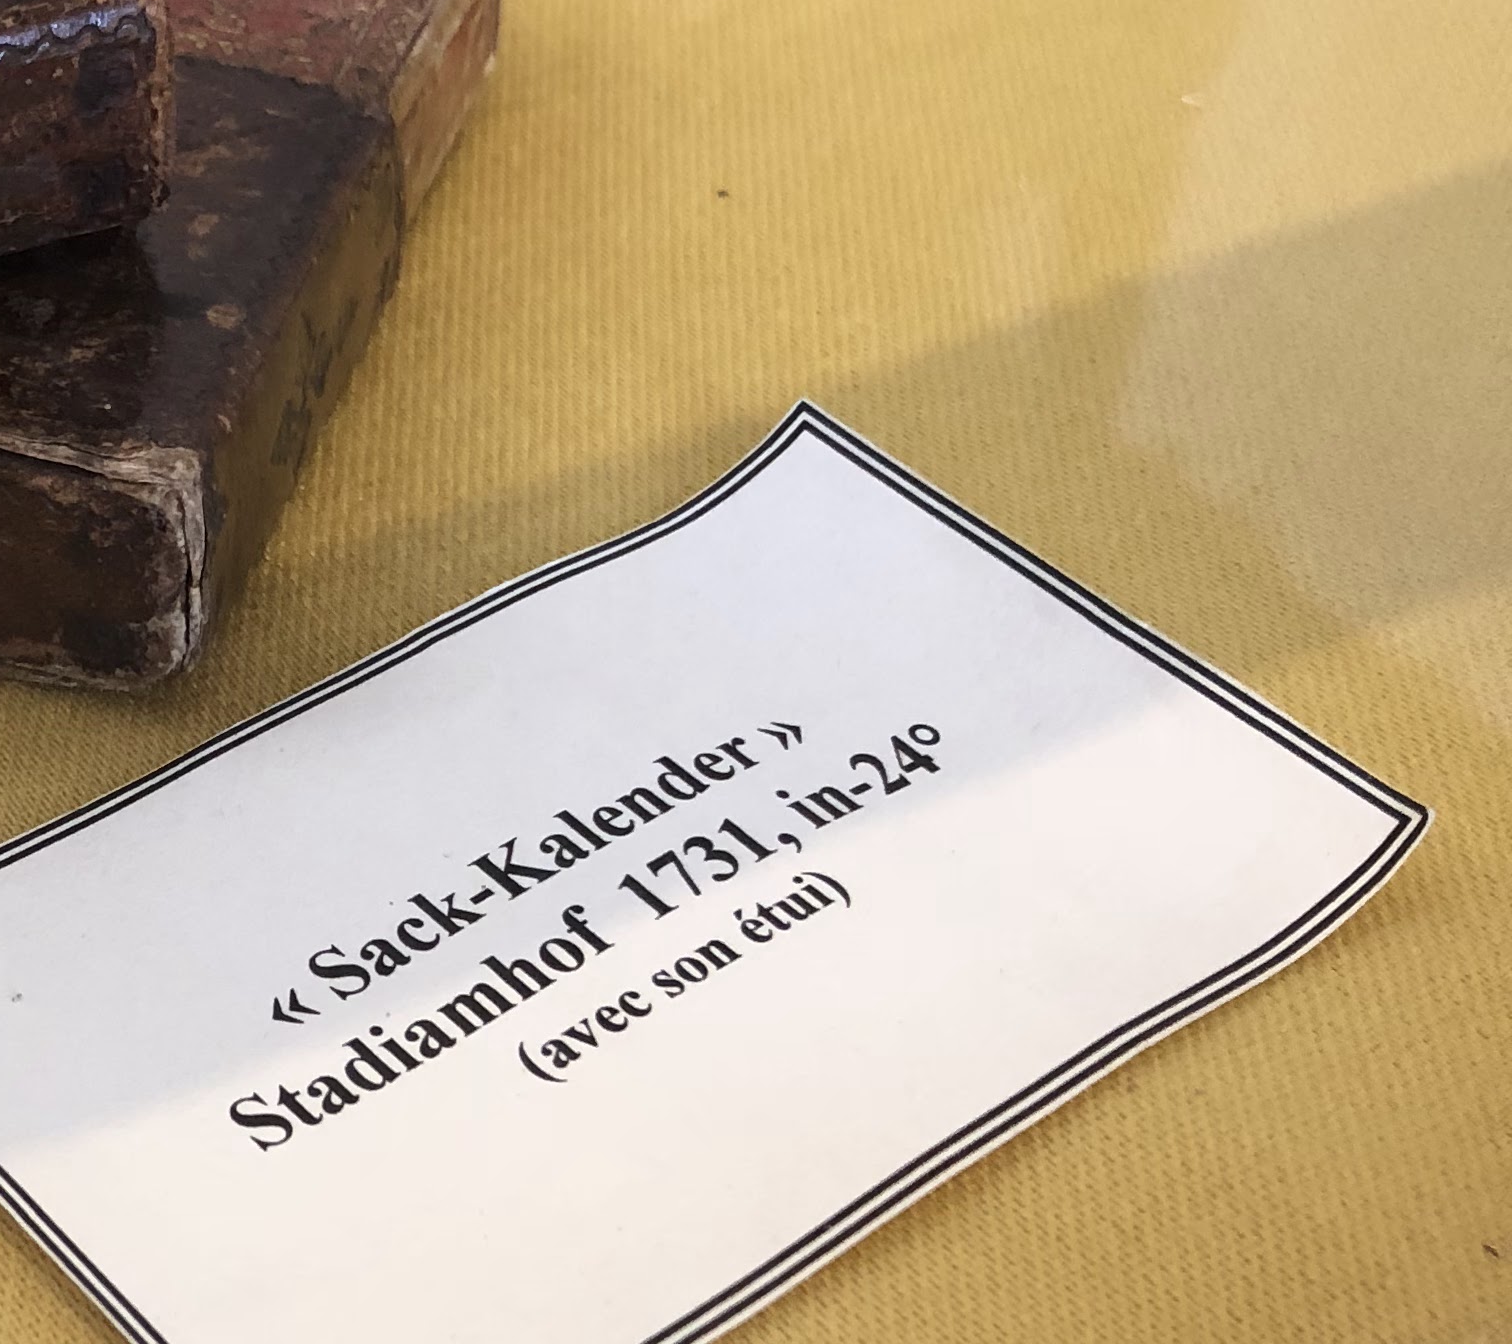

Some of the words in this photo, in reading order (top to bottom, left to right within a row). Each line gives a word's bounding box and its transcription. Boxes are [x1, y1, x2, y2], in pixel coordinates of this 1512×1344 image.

[229, 904, 615, 1152] Stadiamhof
[618, 818, 803, 921] 1731,
[272, 987, 320, 1025] «
[308, 733, 759, 1002] Sack-Kalender
[758, 721, 805, 750] »
[518, 989, 653, 1083] (avec
[651, 936, 743, 998] son
[738, 871, 852, 945] étui)
